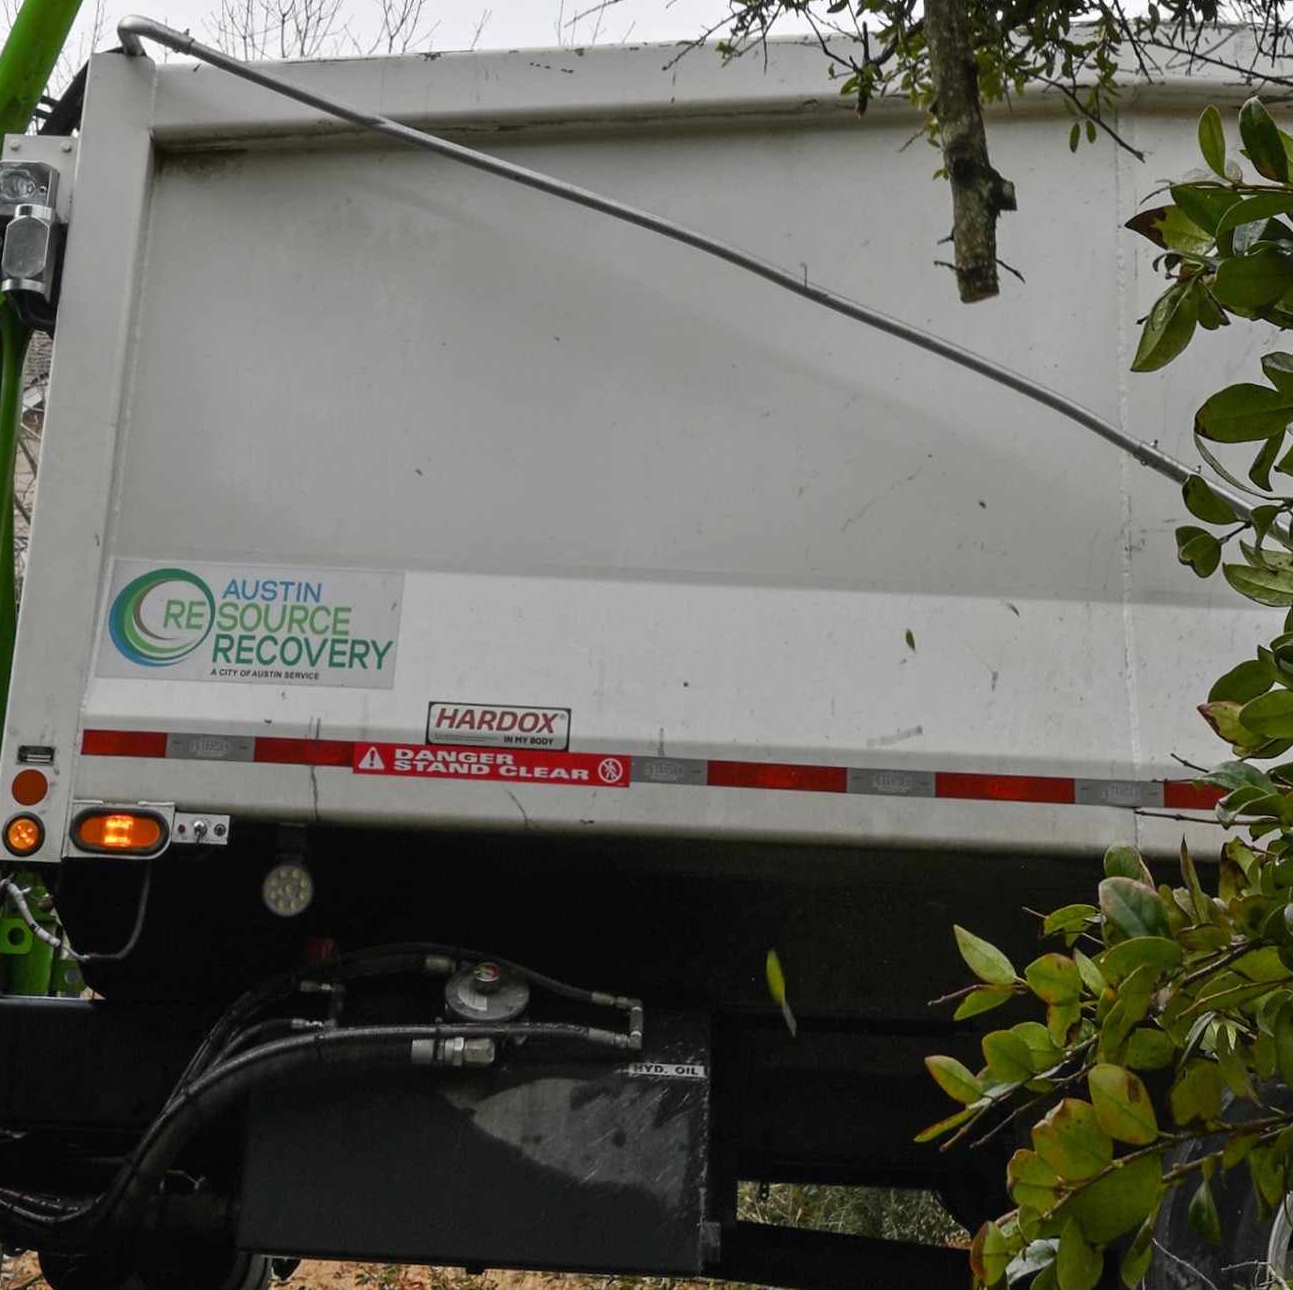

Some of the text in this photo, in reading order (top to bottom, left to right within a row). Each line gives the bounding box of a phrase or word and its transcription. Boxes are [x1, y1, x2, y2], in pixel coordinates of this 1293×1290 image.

[222, 578, 322, 603] AUSTIN
[212, 633, 394, 670] RECOVERY
[210, 668, 217, 676] A
[219, 669, 238, 677] CITY
[252, 670, 283, 679] AUSTIN
[284, 671, 320, 680] SERVICE
[434, 707, 559, 734] HARDOX
[514, 736, 528, 744] MY
[530, 737, 555, 746] BODY
[394, 748, 514, 765] DANGER
[394, 760, 589, 781] STAND CLEAR
[633, 1064, 699, 1076] HYD. OIL
